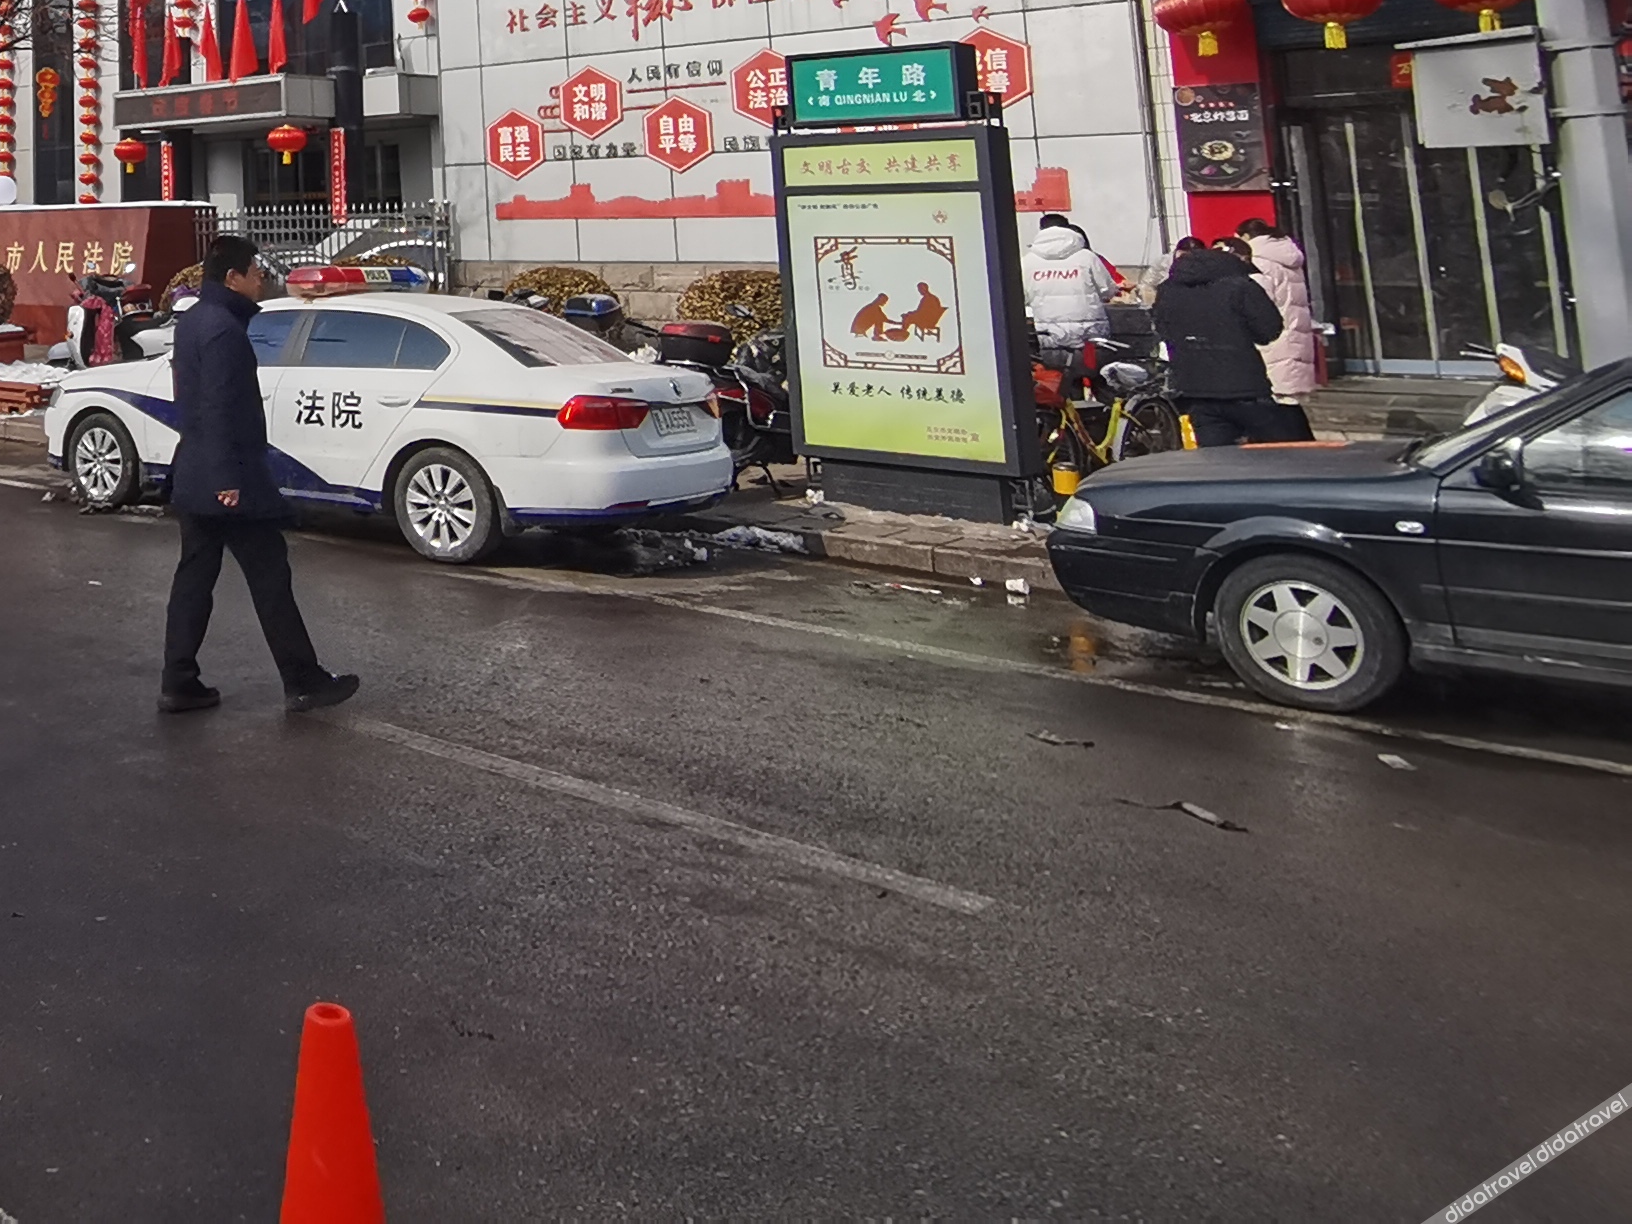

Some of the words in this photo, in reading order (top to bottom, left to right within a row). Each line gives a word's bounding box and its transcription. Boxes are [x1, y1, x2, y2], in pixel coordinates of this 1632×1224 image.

[975, 48, 1008, 72] 信
[746, 68, 786, 88] 公正
[815, 63, 926, 91] 青年路
[572, 83, 607, 102] 文明
[747, 88, 788, 109] 法治
[835, 92, 891, 106] QINGNIAN
[892, 91, 908, 104] LU
[573, 102, 607, 121] 和谐
[659, 114, 694, 134] 自由
[497, 126, 530, 144] 富强
[658, 134, 697, 154] 平等
[723, 136, 771, 152] 民族
[499, 144, 531, 162] 民主
[800, 158, 871, 176] 文明古交
[884, 153, 962, 173] 共建共享
[1033, 269, 1079, 281] CHINA
[831, 381, 892, 397] 关爱老人
[900, 385, 966, 405] 传统美德
[295, 389, 363, 429] 法院
